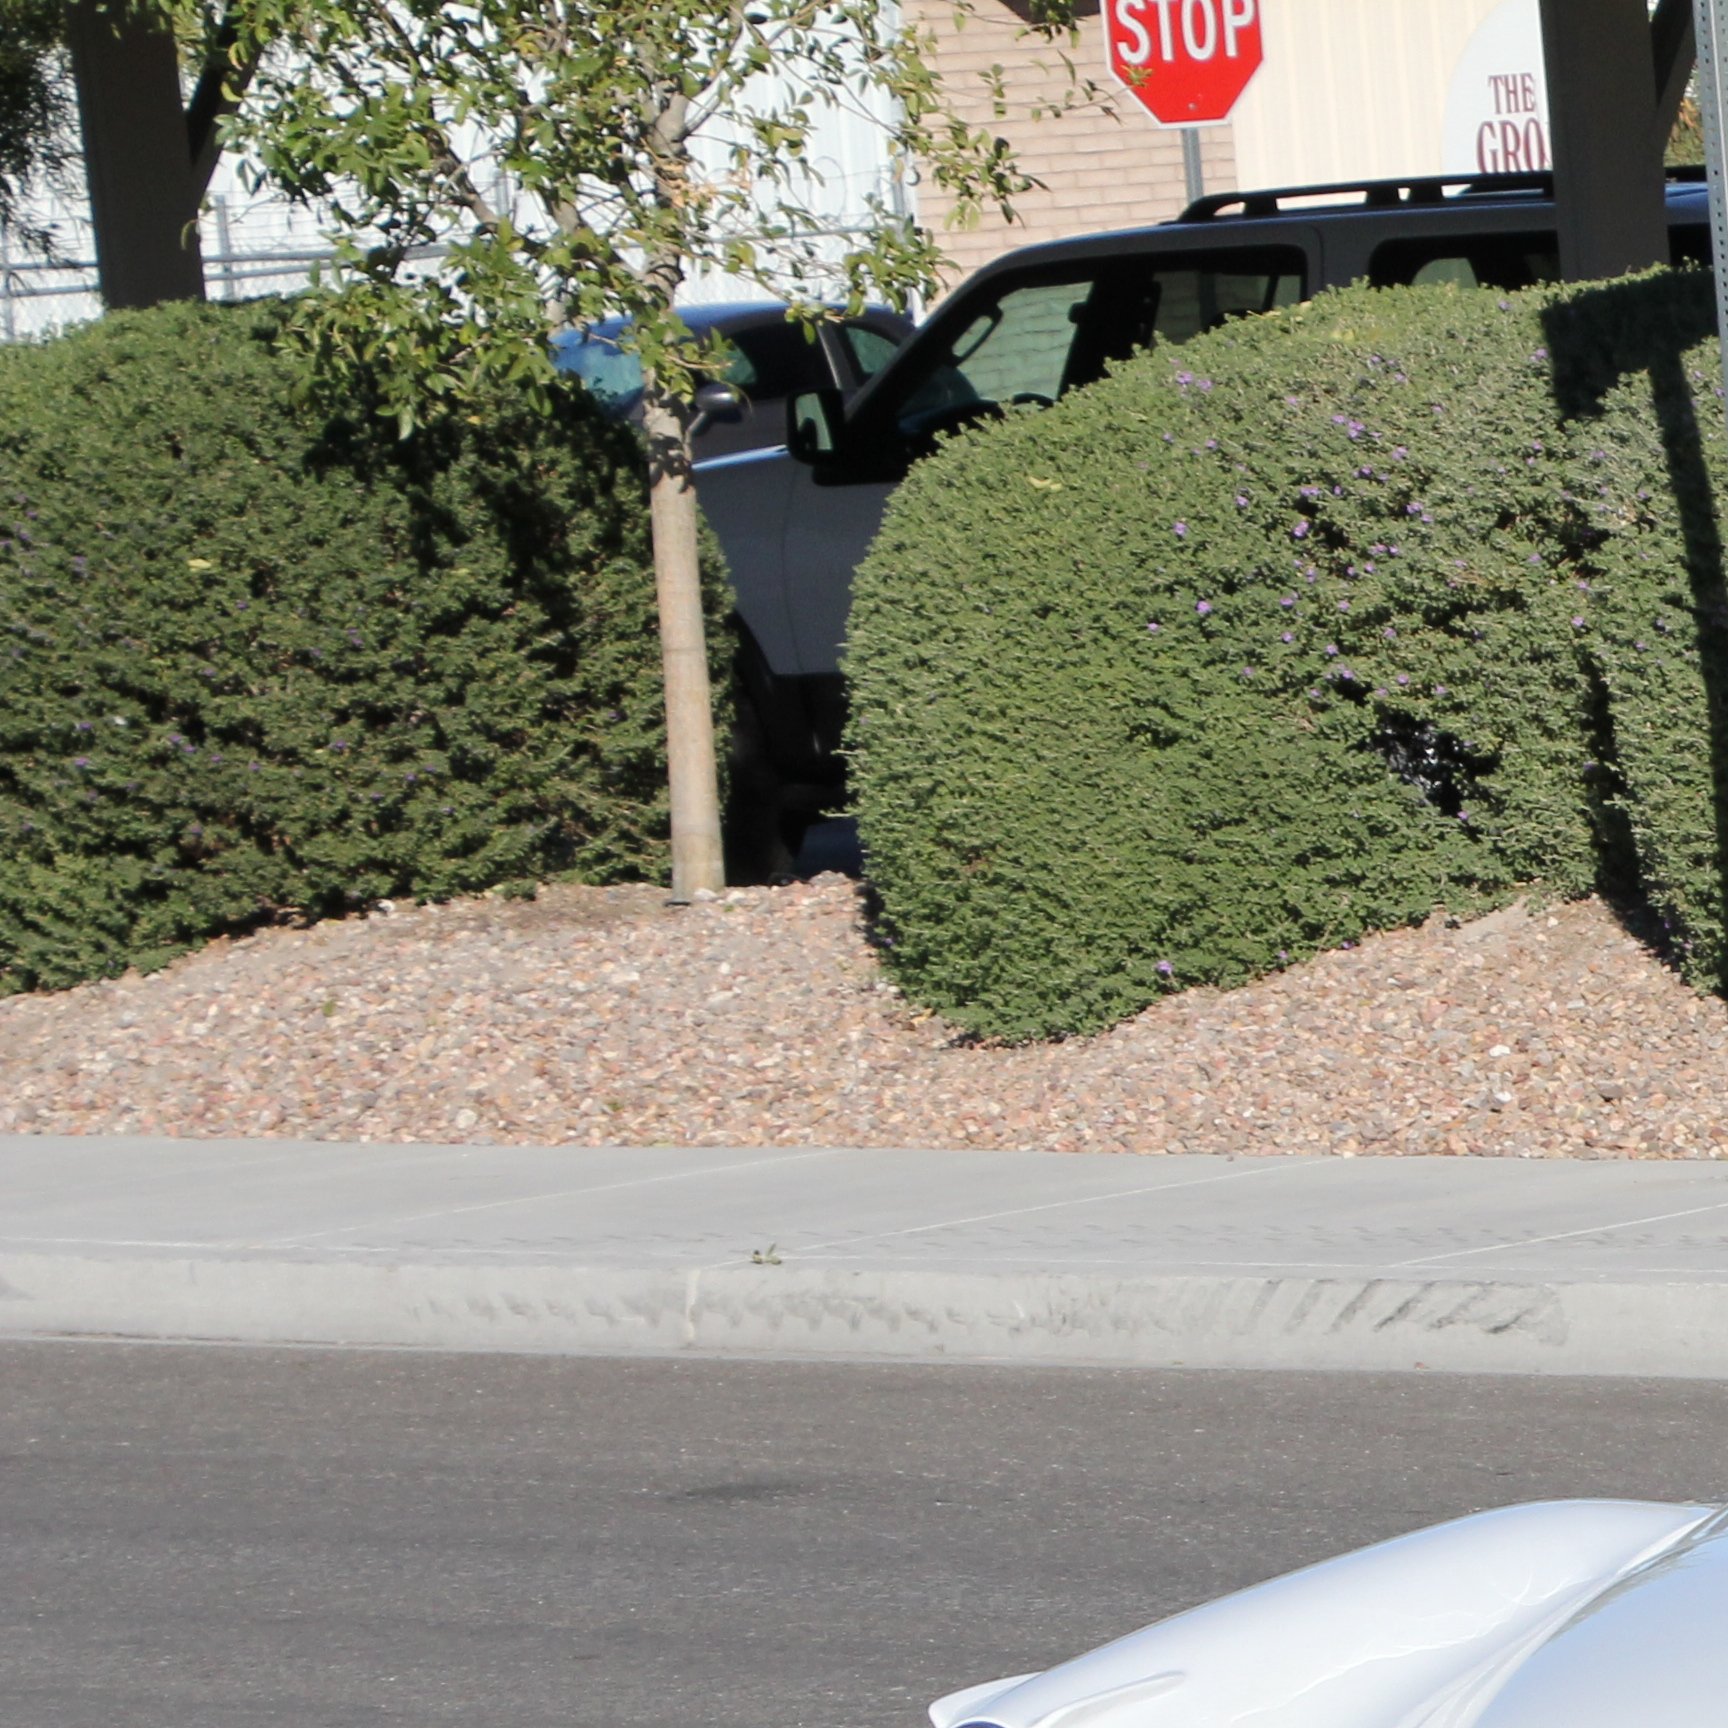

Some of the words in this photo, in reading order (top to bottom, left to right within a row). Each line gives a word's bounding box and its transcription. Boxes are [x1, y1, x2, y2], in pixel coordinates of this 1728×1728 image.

[1115, 0, 1256, 64] STOP
[1488, 72, 1536, 115] THE
[1476, 117, 1546, 173] GRO
